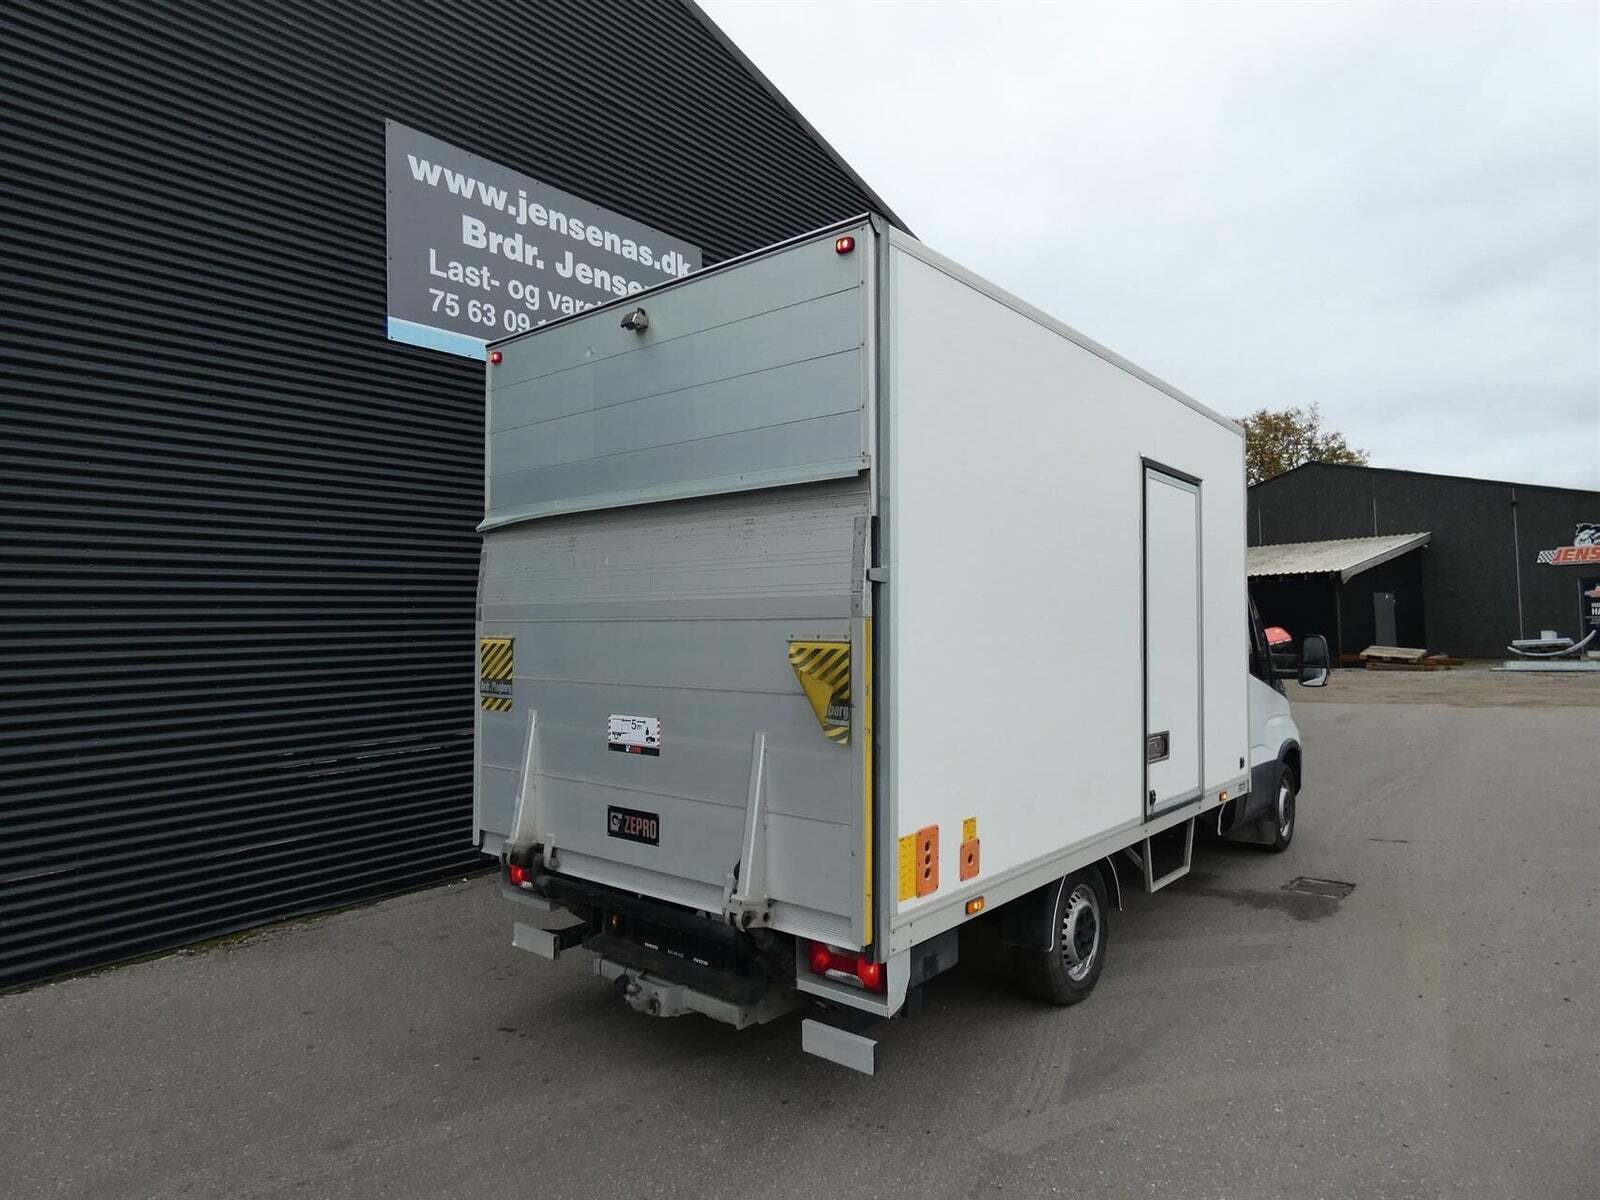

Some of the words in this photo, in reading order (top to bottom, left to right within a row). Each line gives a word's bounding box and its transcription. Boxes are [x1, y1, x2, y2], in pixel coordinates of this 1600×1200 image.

[407, 154, 691, 277] www.jensenas.dk
[429, 248, 500, 291] Last-
[508, 280, 540, 310] og
[462, 214, 544, 269] Brdr.
[555, 251, 648, 297] Jense
[428, 288, 460, 317] 75
[467, 300, 497, 327] 63
[503, 309, 530, 333] 09
[624, 815, 657, 839] ZEPRO
